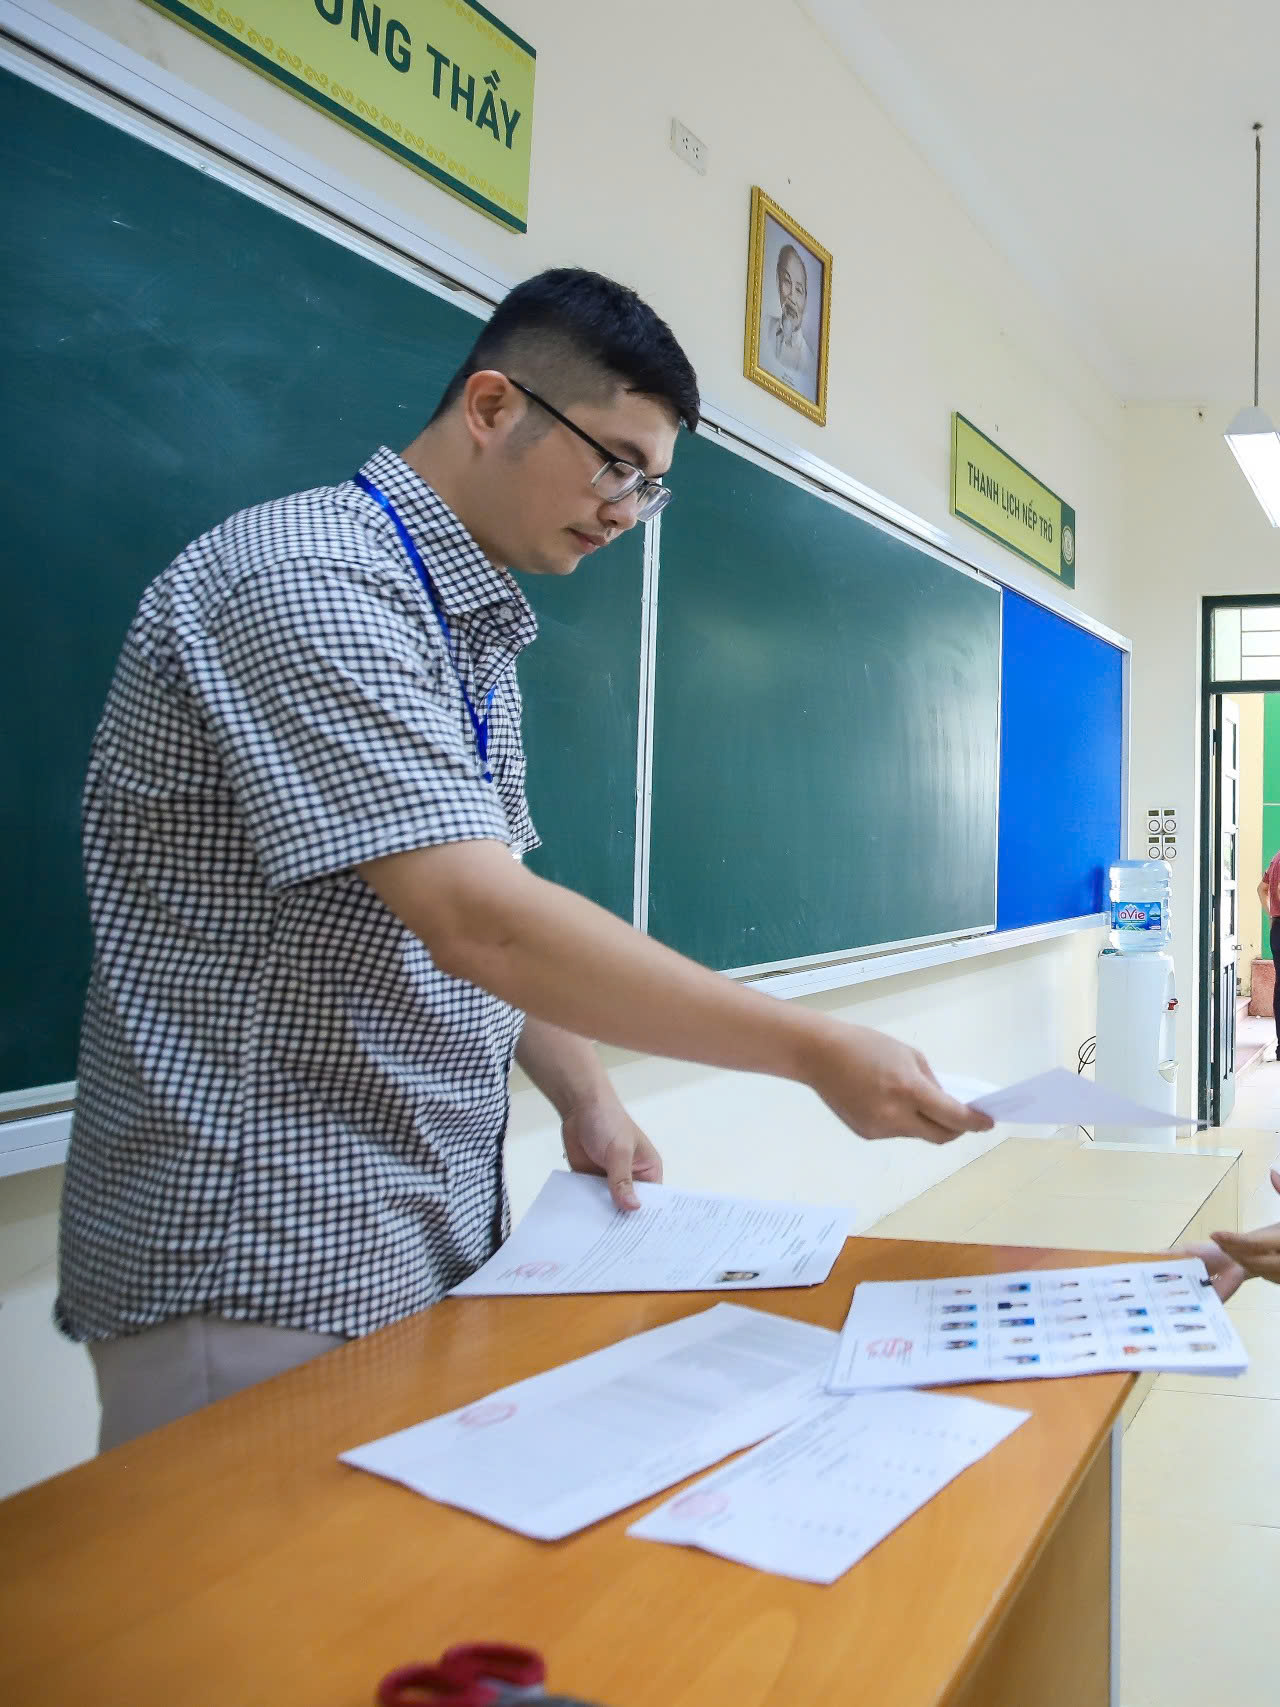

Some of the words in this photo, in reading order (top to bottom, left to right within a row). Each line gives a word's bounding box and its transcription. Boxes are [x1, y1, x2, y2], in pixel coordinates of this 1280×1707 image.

[426, 43, 521, 150] THẦY
[967, 461, 999, 505] THANH
[1001, 486, 1020, 520] LỊCH
[1022, 500, 1038, 531] NẾP
